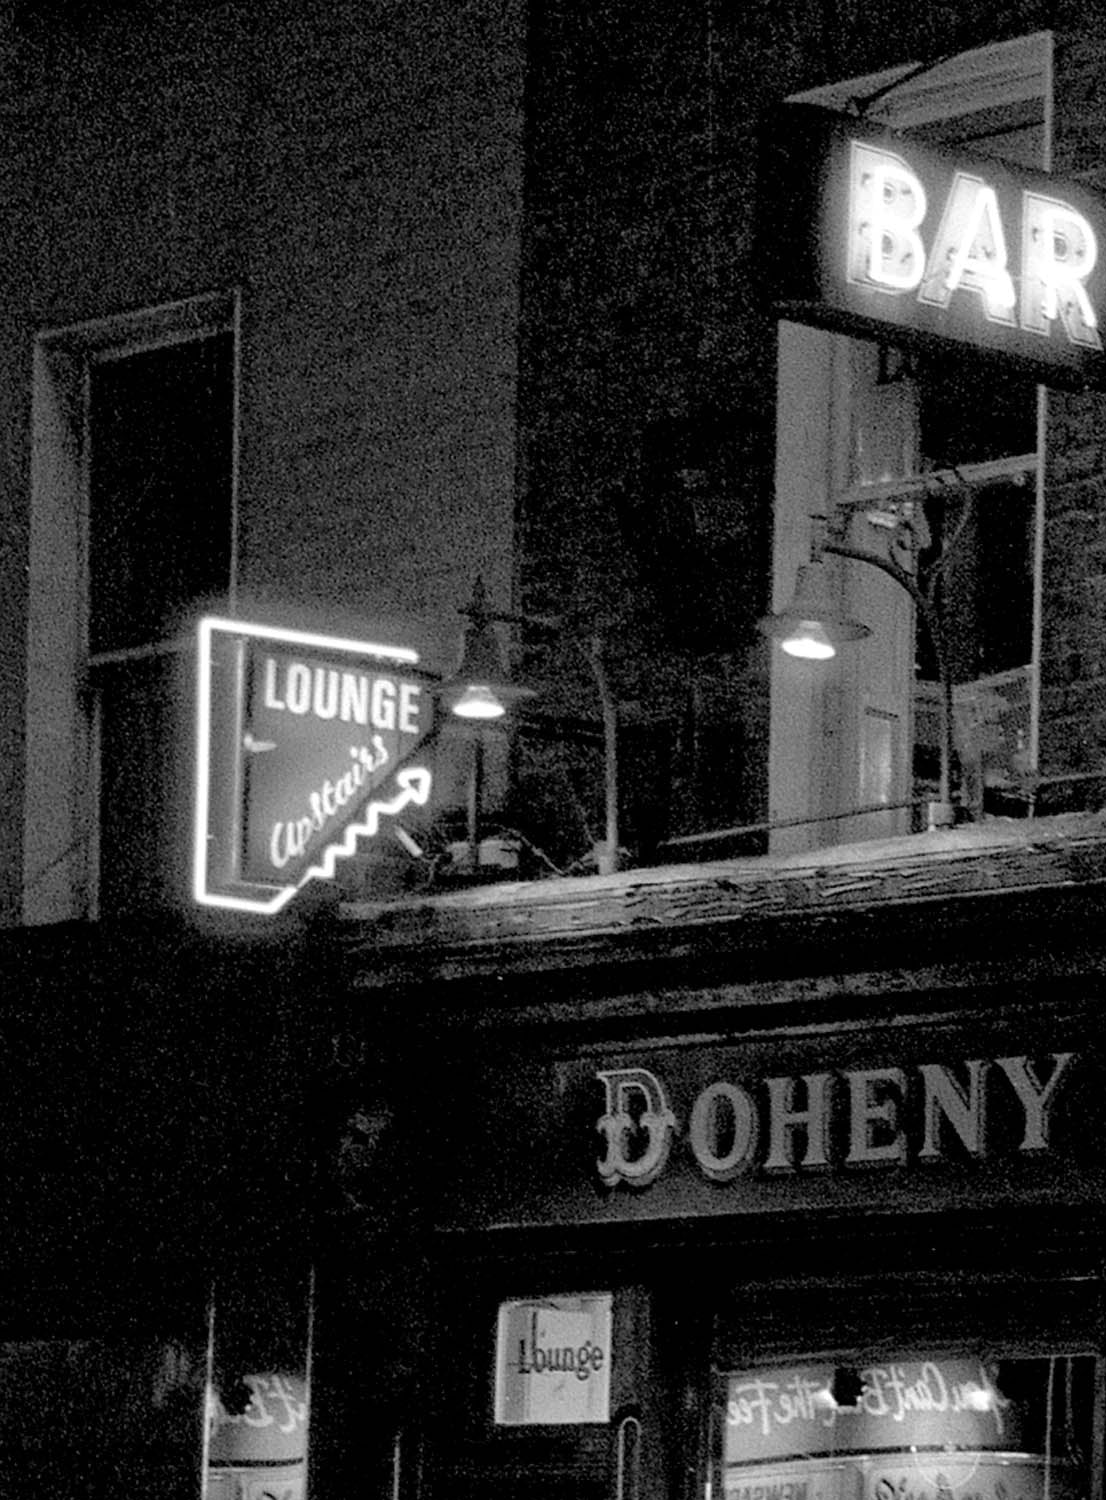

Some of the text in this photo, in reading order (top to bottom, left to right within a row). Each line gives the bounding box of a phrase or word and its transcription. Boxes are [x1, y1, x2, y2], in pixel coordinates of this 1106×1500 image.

[847, 140, 1102, 351] BAR
[264, 657, 421, 735] LOUNGE
[269, 733, 391, 869] Upstairs
[596, 1052, 1076, 1187] DOHENY
[517, 1338, 604, 1381] Lounge
